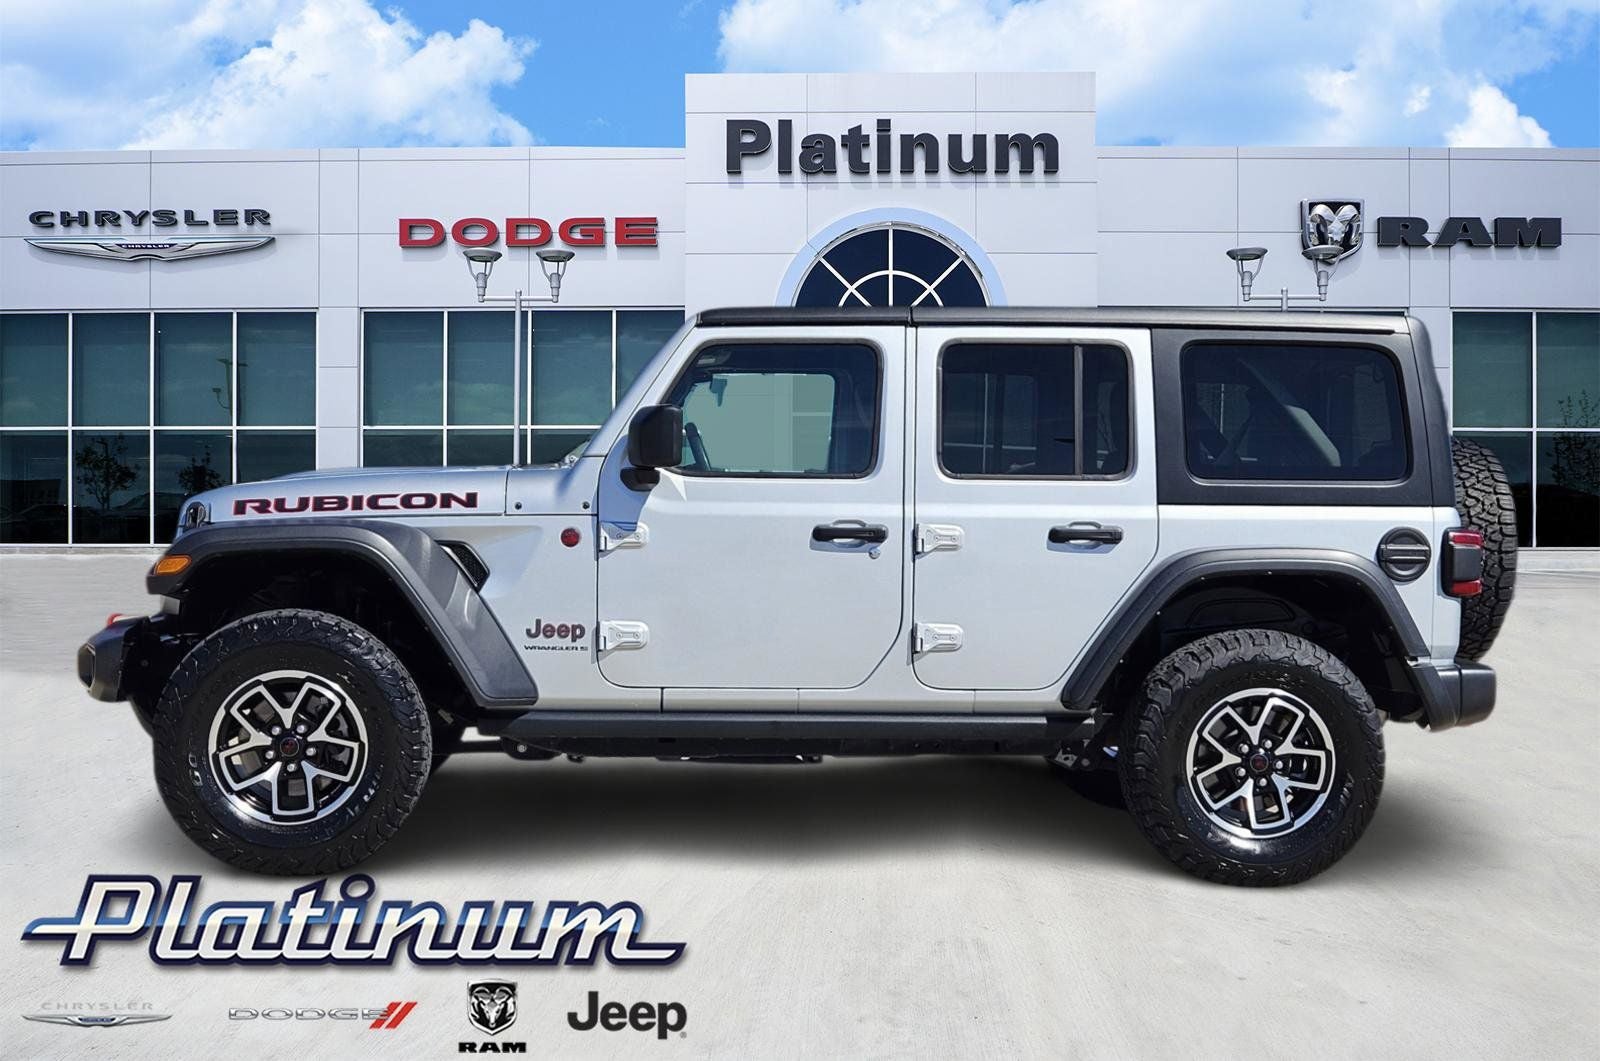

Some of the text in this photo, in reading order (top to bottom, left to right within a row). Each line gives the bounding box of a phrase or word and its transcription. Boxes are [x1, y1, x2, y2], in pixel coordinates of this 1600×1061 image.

[726, 119, 1060, 175] Platinum
[29, 209, 271, 227] CHRYSLER
[1377, 216, 1562, 248] RAM
[399, 217, 658, 248] DODGE
[233, 492, 478, 515] RUBICON
[525, 618, 586, 643] Jeep
